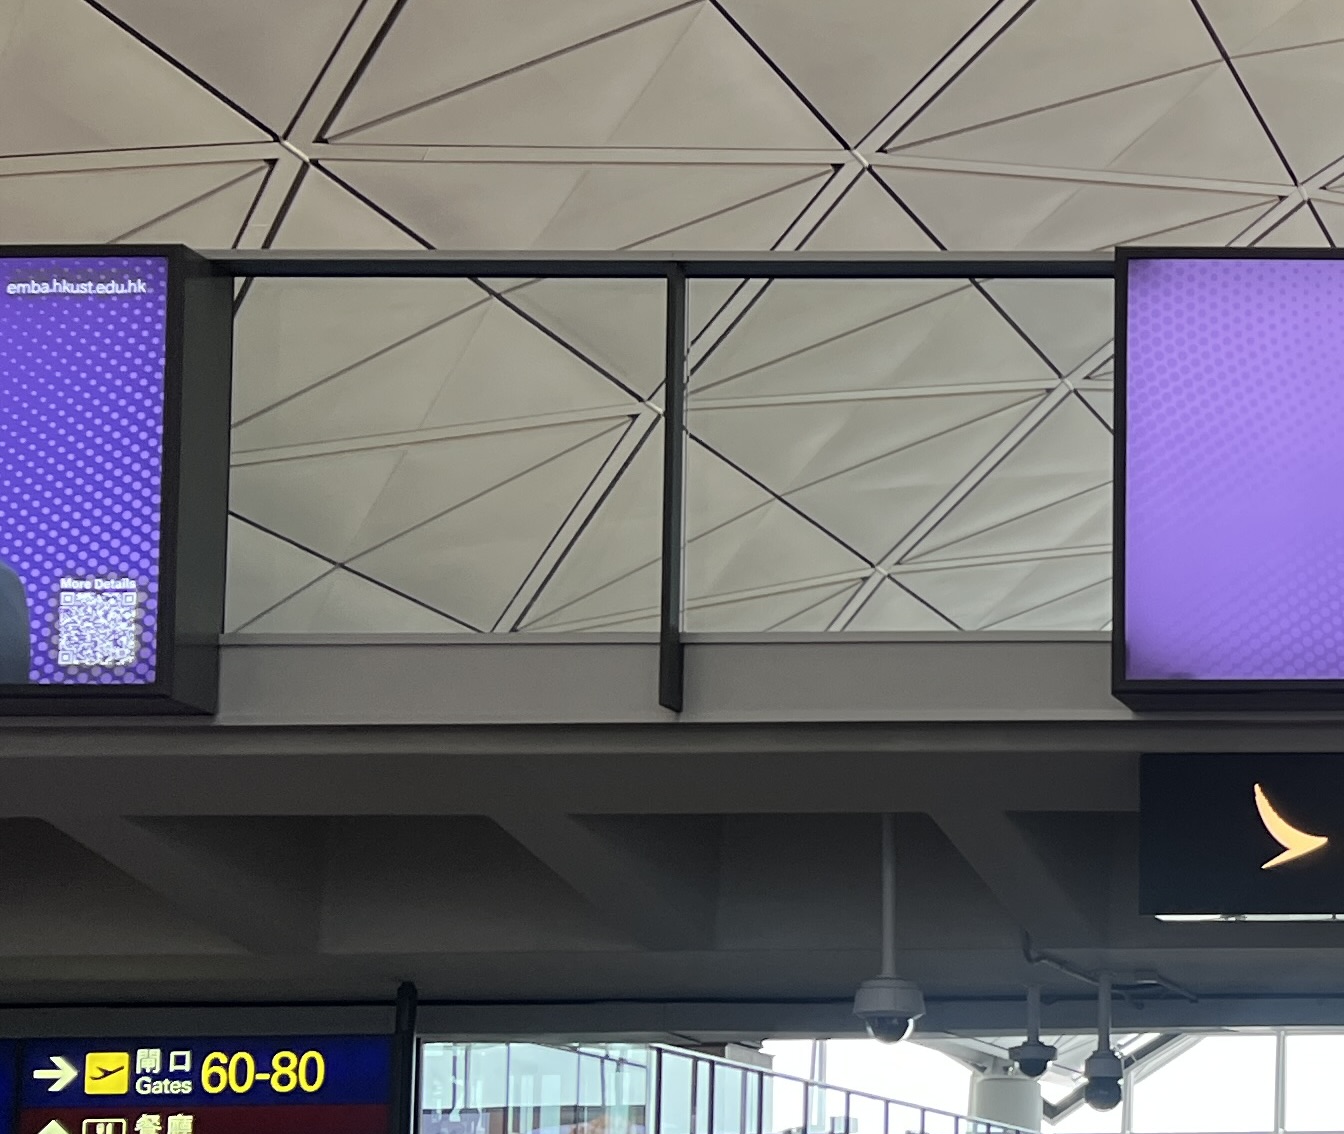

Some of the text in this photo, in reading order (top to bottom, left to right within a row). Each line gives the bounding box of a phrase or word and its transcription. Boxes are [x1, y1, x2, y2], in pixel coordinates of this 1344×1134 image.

[6, 278, 147, 295] emba.hkust.edu.hk
[60, 577, 137, 590] More Details
[135, 1048, 192, 1074] 閘口
[201, 1050, 325, 1094] 60-80
[135, 1076, 193, 1095] Gates
